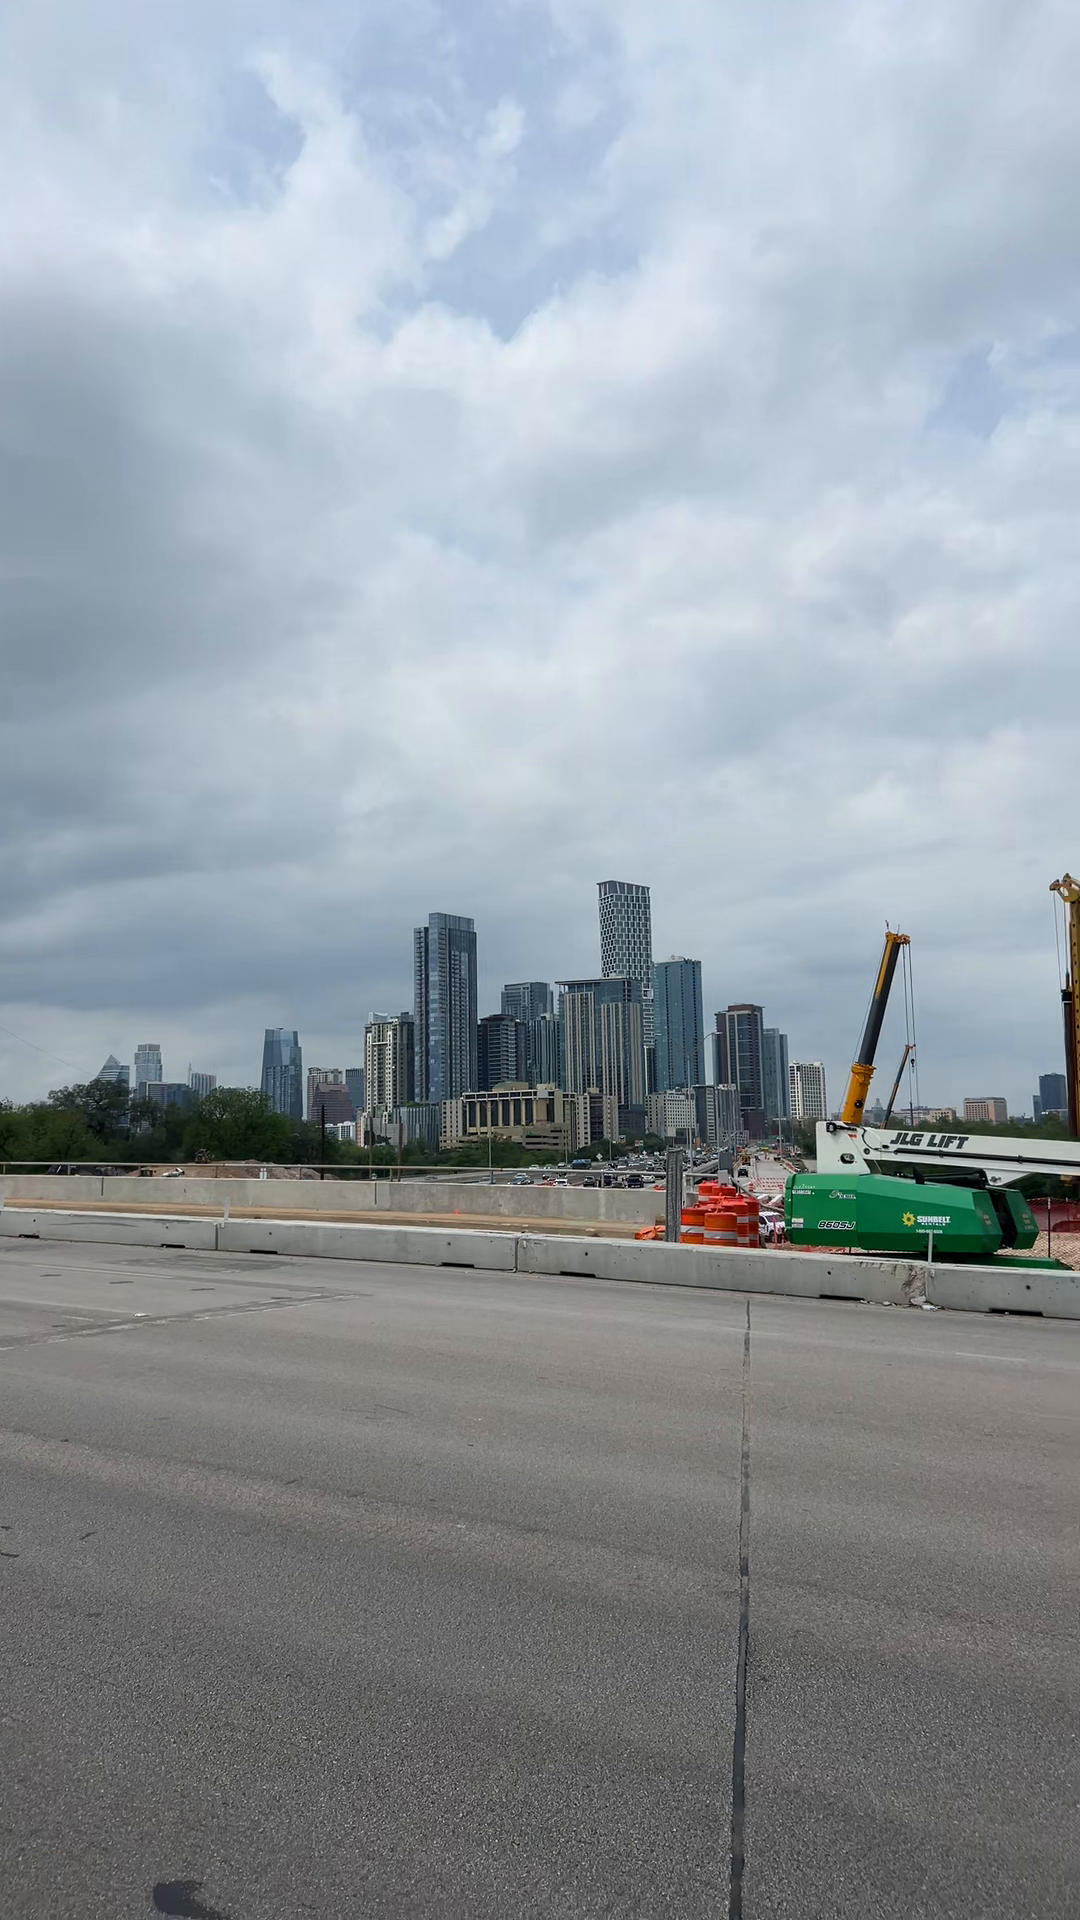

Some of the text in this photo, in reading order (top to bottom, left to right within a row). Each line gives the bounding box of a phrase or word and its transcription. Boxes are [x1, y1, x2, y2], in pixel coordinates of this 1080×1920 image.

[890, 1132, 969, 1149] JLG LIFT
[916, 1215, 951, 1223] SUNBELT
[817, 1220, 856, 1230] 860SJ
